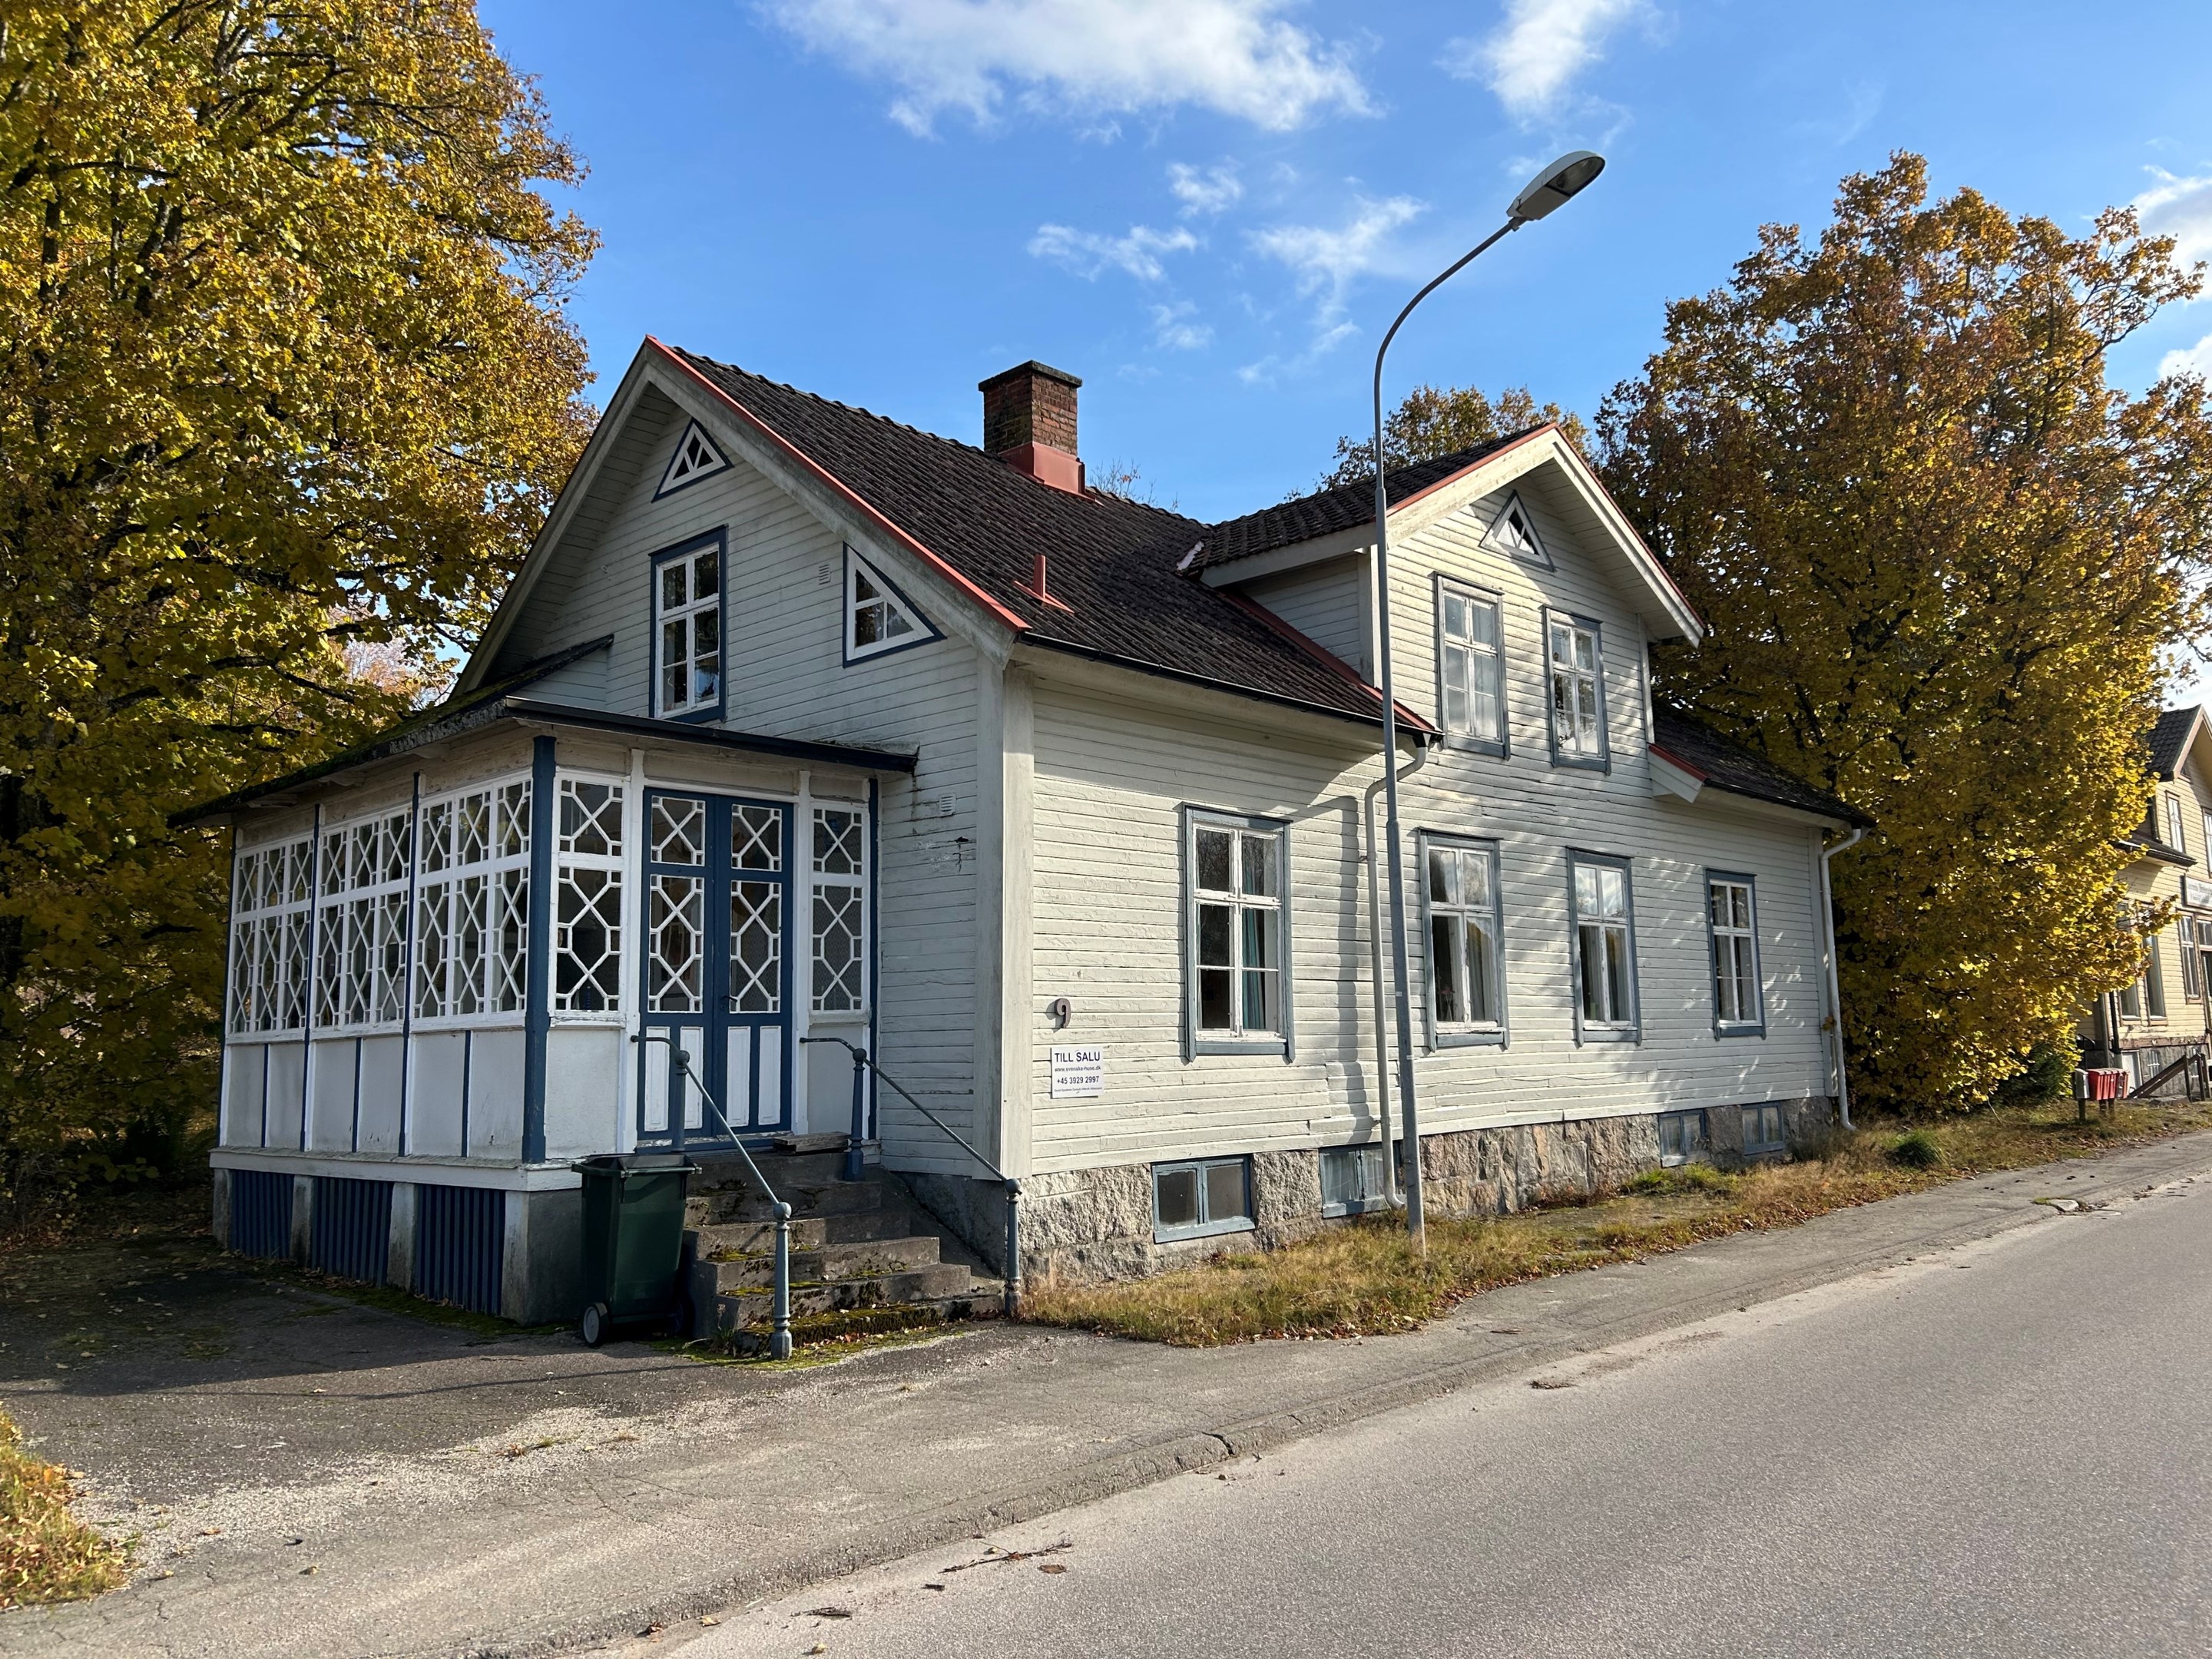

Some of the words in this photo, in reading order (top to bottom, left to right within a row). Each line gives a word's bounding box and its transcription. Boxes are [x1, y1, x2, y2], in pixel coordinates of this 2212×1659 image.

[1055, 998, 1071, 1028] 9
[1055, 1052, 1074, 1062] TILL
[1076, 1051, 1100, 1061] SALU
